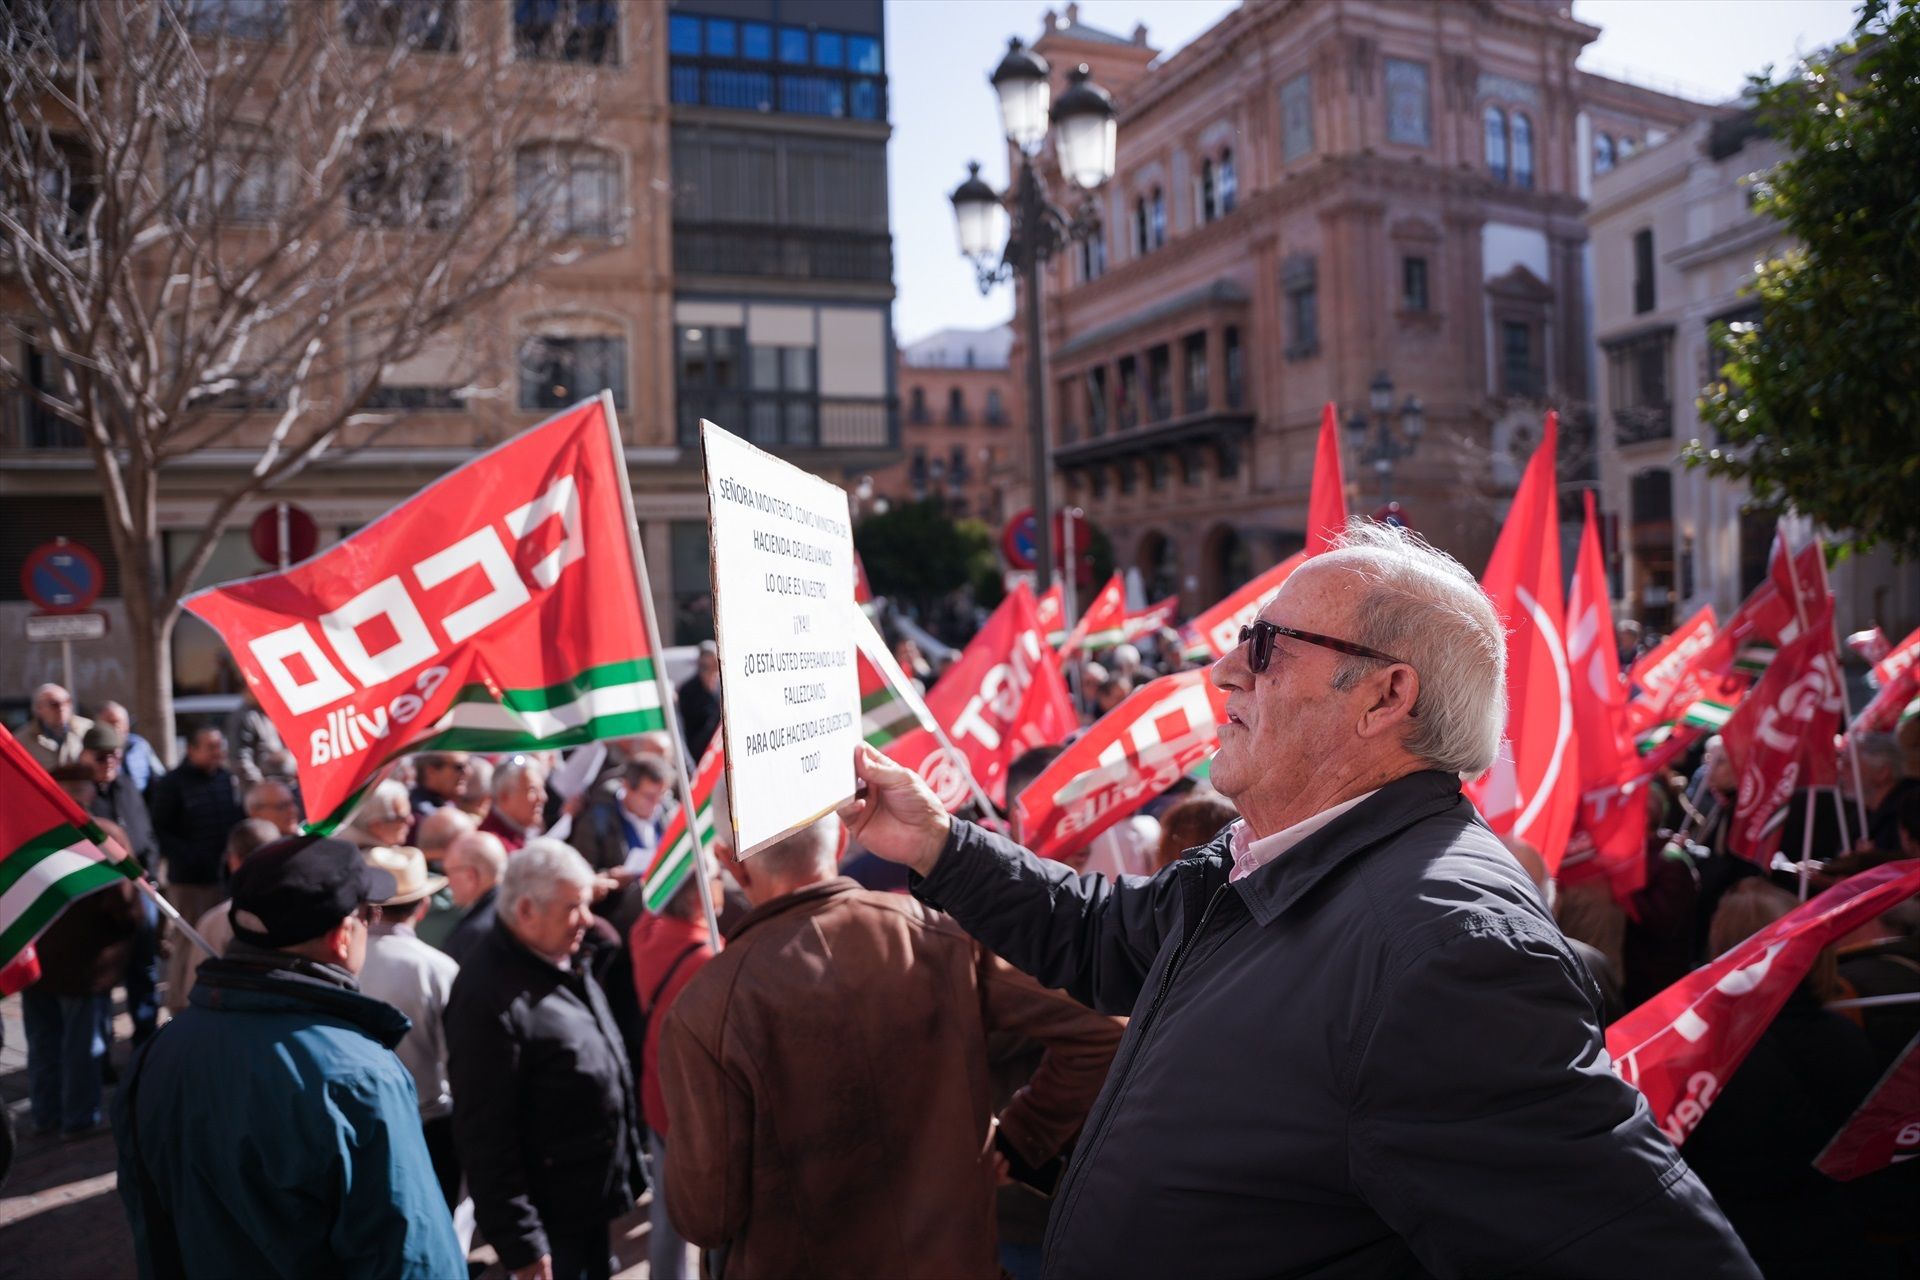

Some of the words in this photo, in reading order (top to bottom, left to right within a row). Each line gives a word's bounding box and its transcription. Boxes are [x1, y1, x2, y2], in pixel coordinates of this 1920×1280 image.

[719, 476, 755, 507] SEÑORA
[796, 506, 815, 528] COMO
[753, 529, 792, 556] HACIENDA
[793, 540, 832, 567] DEVUELVANOS
[765, 572, 776, 592] LO
[776, 574, 792, 596] QUE
[793, 576, 801, 595] ES
[802, 578, 827, 600] NUESTRO
[744, 652, 755, 677] ¿O
[757, 648, 776, 674] ESTÁ
[776, 652, 798, 672] USTED
[799, 651, 831, 670] ESPERANDO
[783, 682, 827, 706] FALLEZCAMOS
[746, 731, 769, 757] PARA
[769, 728, 785, 751] QUE
[786, 720, 819, 747] HACIENDA
[818, 717, 825, 736] SE
[826, 713, 842, 734] QUEDE
[841, 711, 853, 729] CON
[801, 750, 821, 774] TODO?
